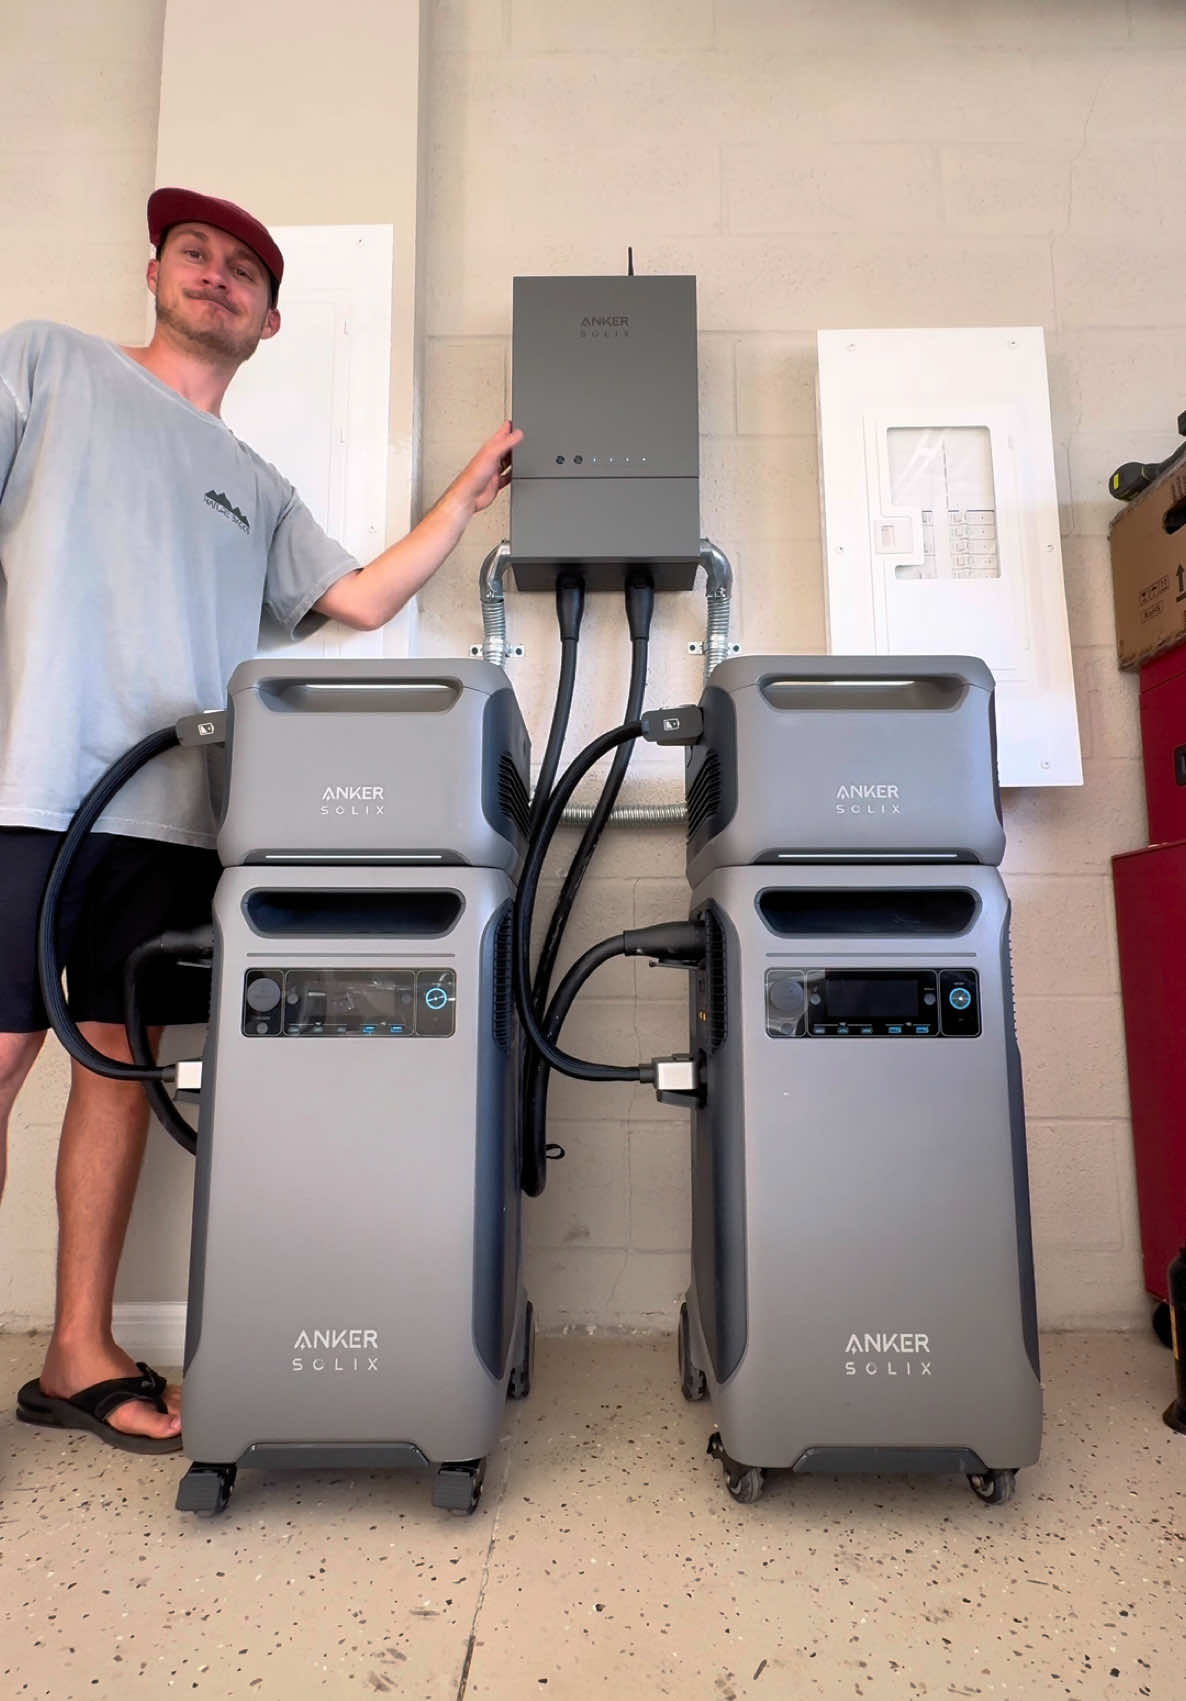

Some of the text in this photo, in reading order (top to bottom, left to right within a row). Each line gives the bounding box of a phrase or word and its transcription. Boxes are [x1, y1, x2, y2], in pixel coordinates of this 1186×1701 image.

[581, 316, 629, 328] ANKER
[322, 786, 384, 800] ANKER
[836, 785, 900, 800] ANKER
[320, 805, 384, 815] SOLIX
[835, 803, 901, 814] SOLIX
[294, 1329, 378, 1350] ANKER
[845, 1333, 930, 1354] ANKER
[292, 1357, 379, 1371] SOLIX
[845, 1361, 931, 1375] SOLIX
